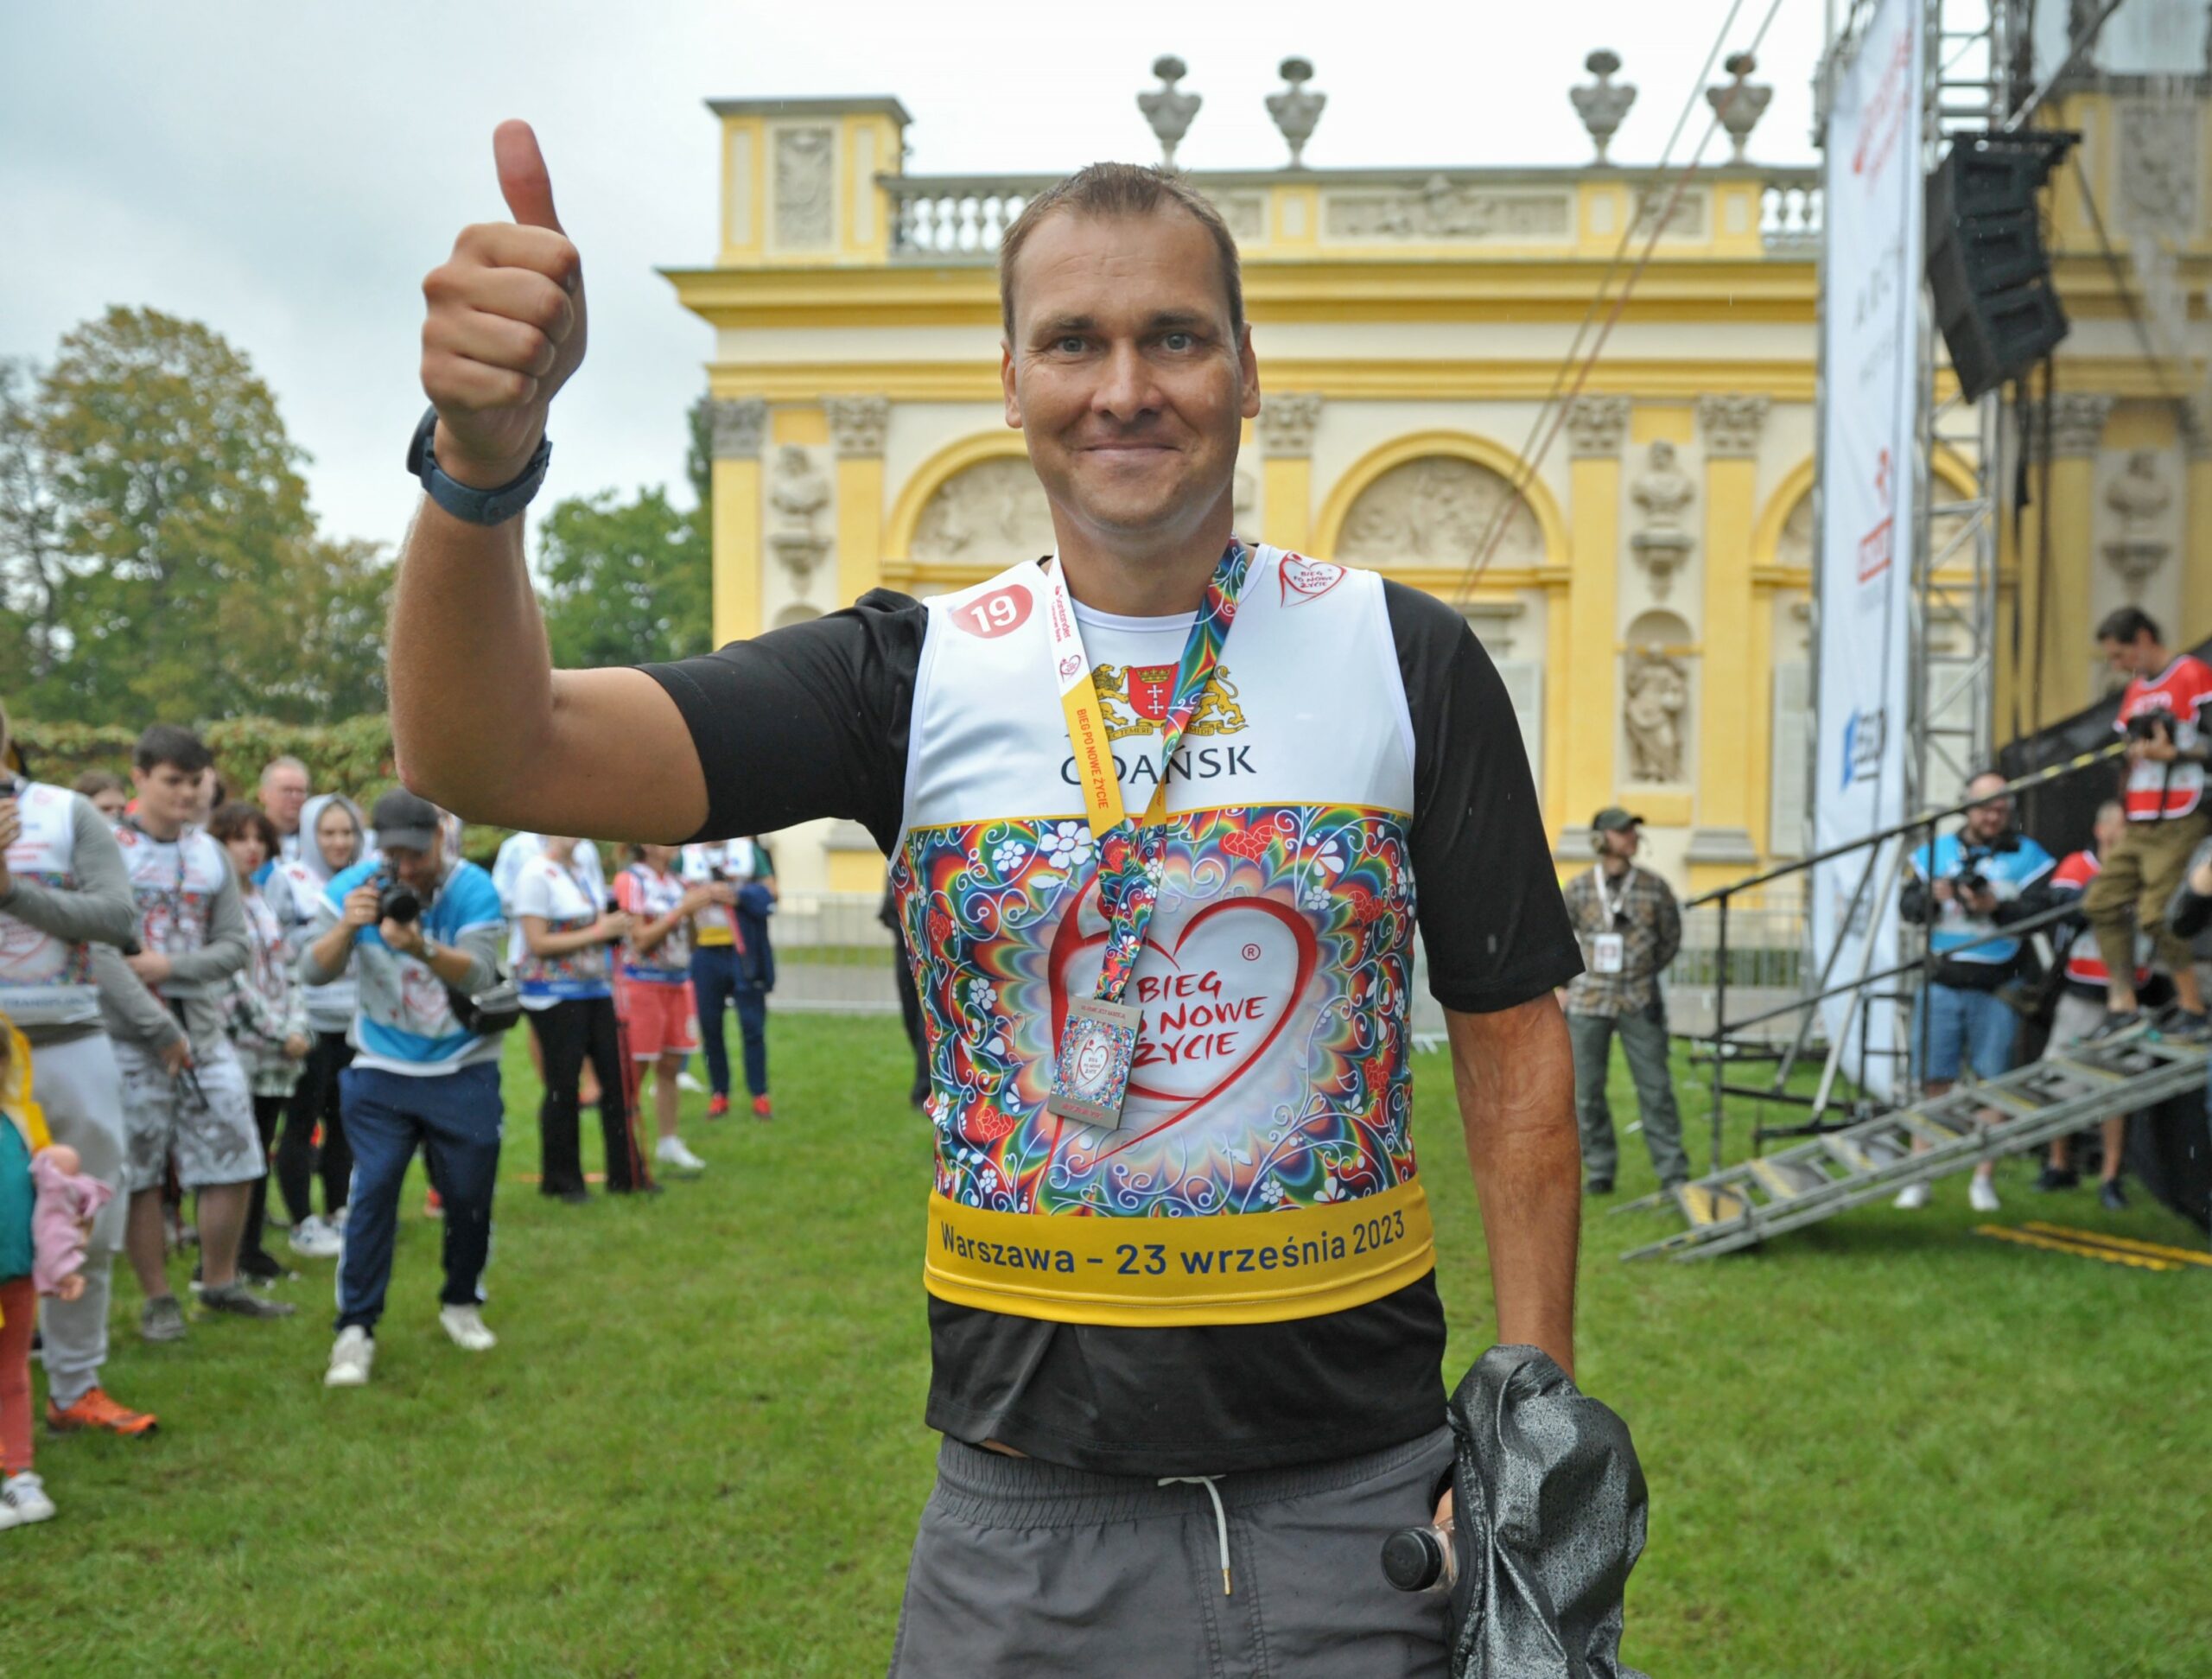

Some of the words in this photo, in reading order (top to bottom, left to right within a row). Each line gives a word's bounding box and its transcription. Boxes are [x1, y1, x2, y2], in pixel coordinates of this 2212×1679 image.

[970, 595, 1017, 633] 19
[1077, 709, 1090, 732] BIEG
[1083, 731, 1094, 745] PO
[1086, 746, 1102, 776] NOWE
[1093, 777, 1109, 809] ŻYCIE
[1136, 970, 1223, 1003] BIEG
[1160, 996, 1268, 1034] NOWE
[1132, 1032, 1239, 1068] ŻYCIE
[941, 1220, 1075, 1273] Warszawa
[1116, 1244, 1166, 1275] 23
[1180, 1231, 1345, 1275] września
[1353, 1210, 1404, 1255] 2023
